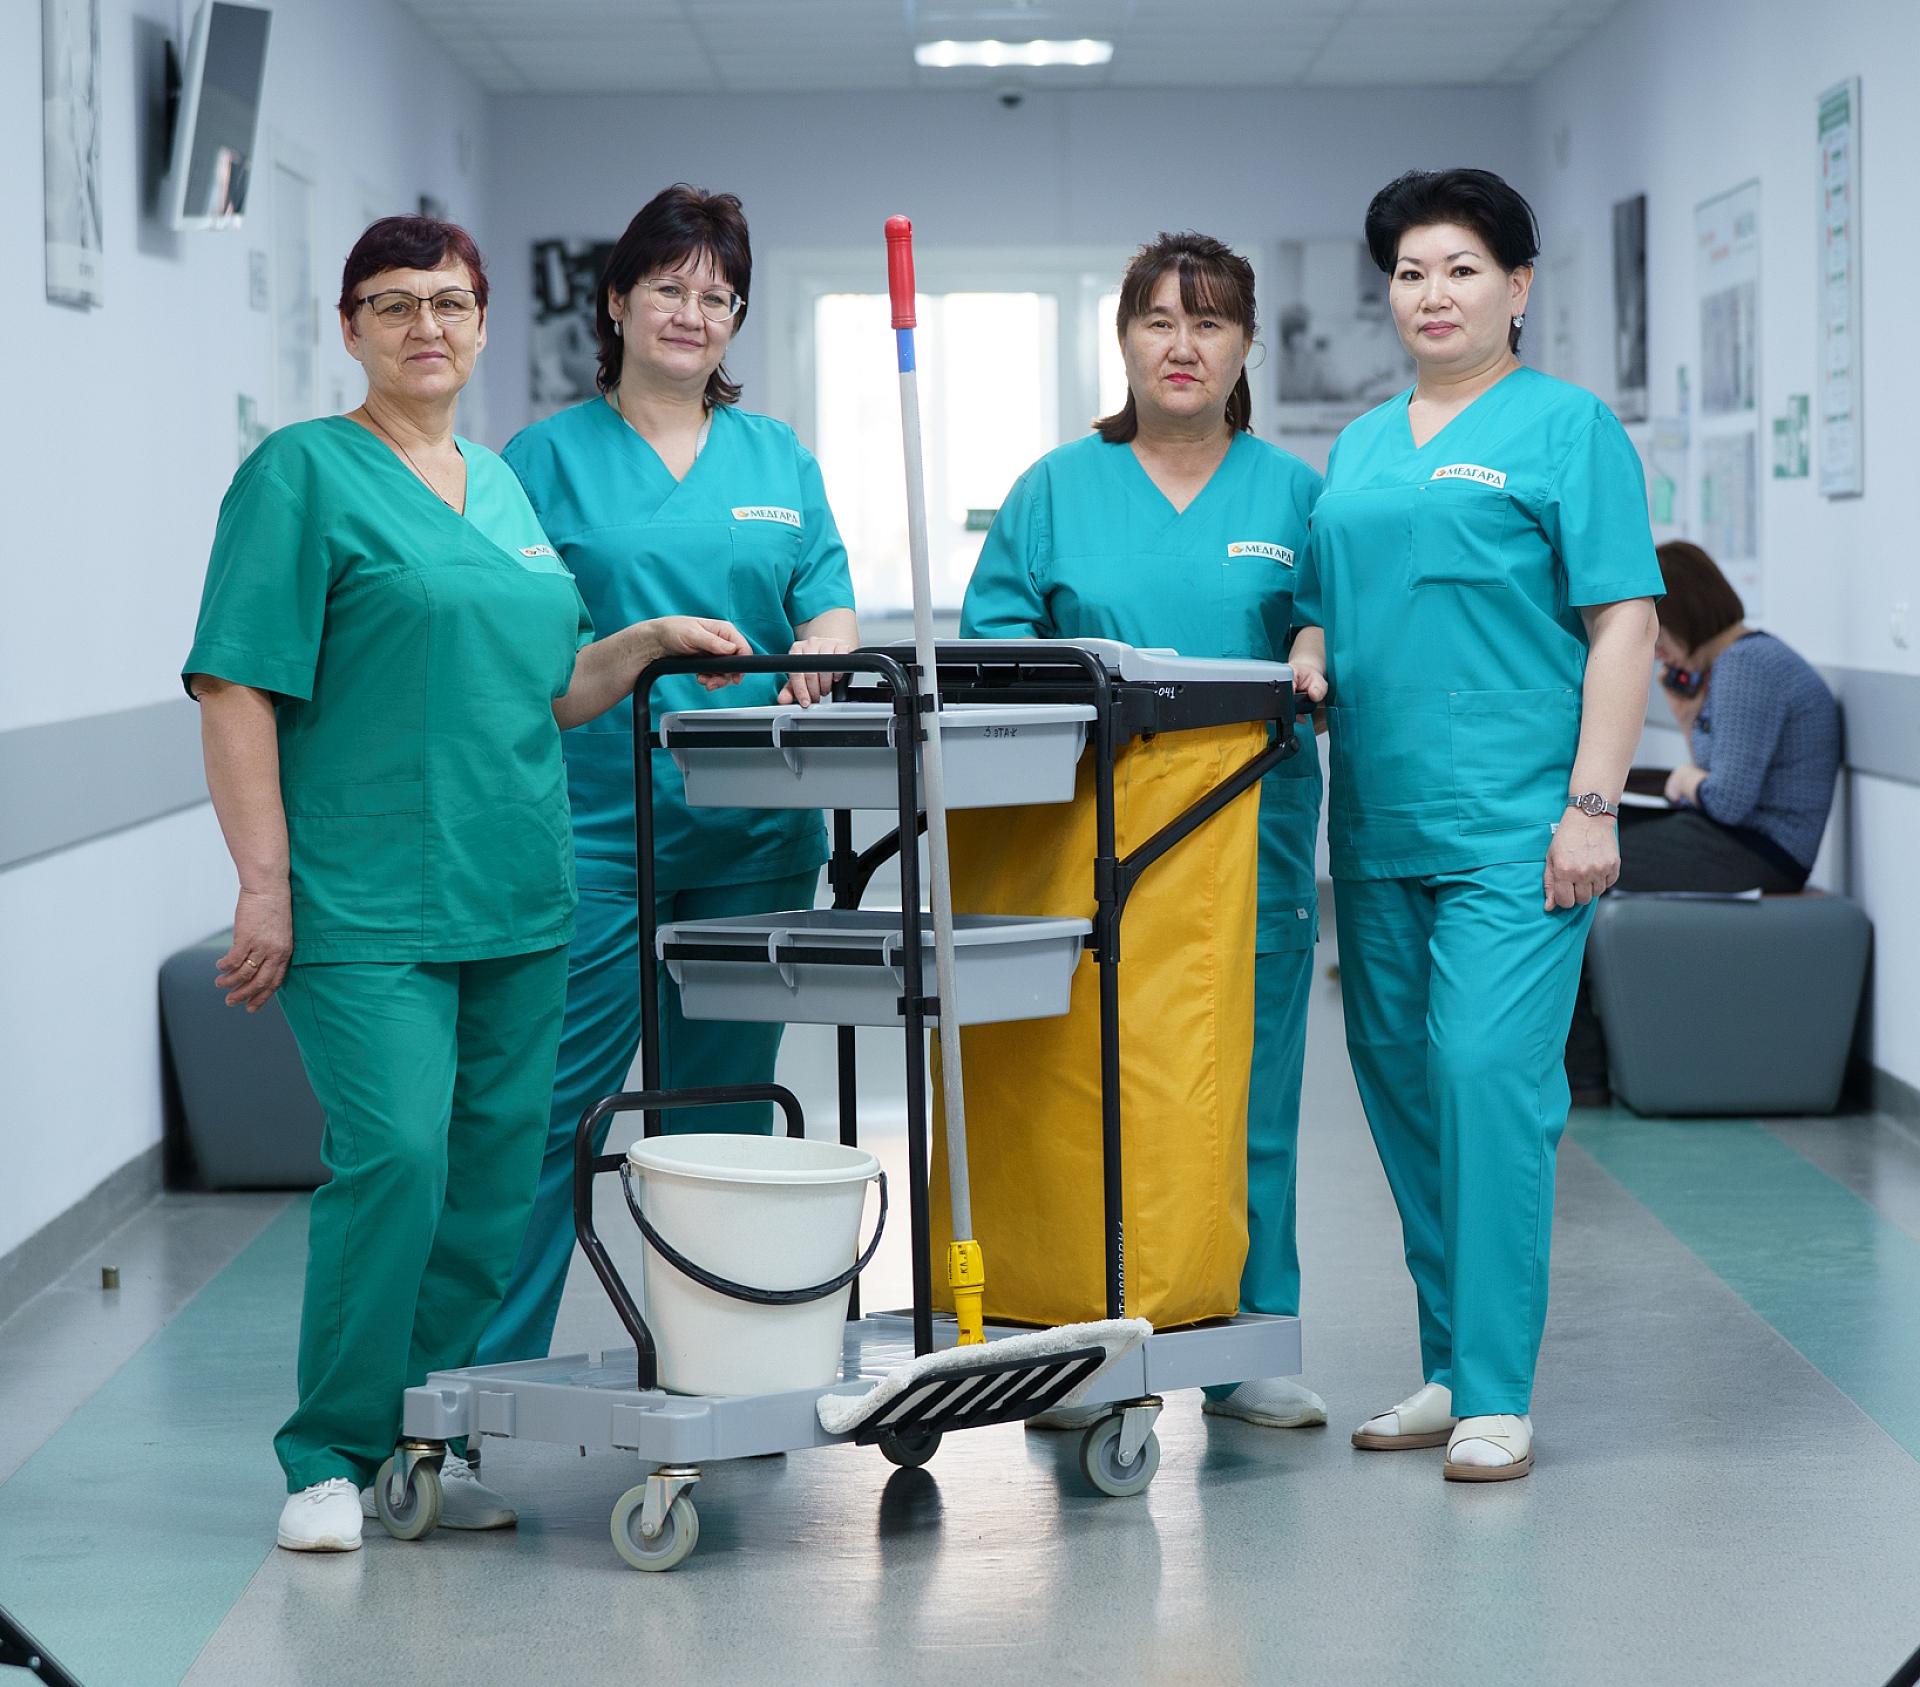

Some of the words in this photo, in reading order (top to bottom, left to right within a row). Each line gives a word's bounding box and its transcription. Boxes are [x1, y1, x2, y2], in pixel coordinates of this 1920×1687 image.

[1447, 467, 1501, 485] МЕДГАРД
[750, 509, 798, 523] МЕДГАРД
[1245, 545, 1292, 563] МЕДГАРД
